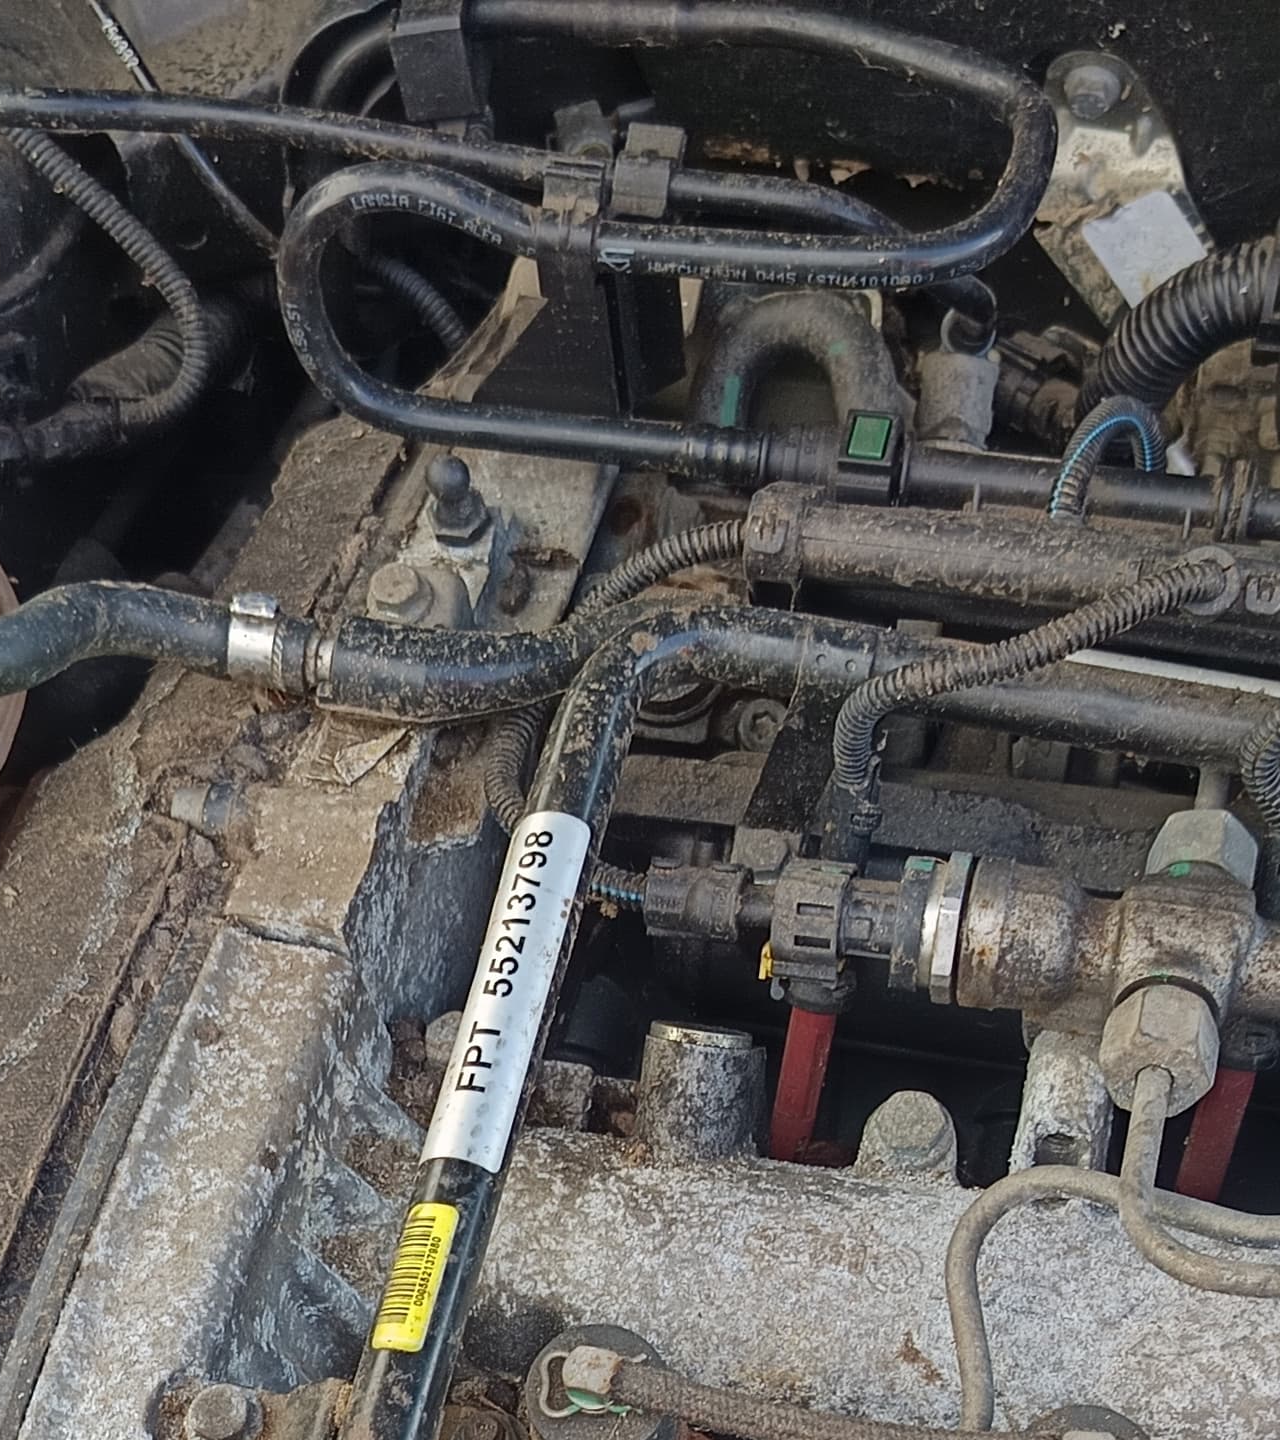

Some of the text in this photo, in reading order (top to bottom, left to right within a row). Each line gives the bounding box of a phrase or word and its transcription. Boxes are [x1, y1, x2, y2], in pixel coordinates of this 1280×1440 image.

[351, 194, 408, 209] LANCIA
[418, 199, 456, 224] FIAT
[455, 830, 554, 1094] FPT 55213798
